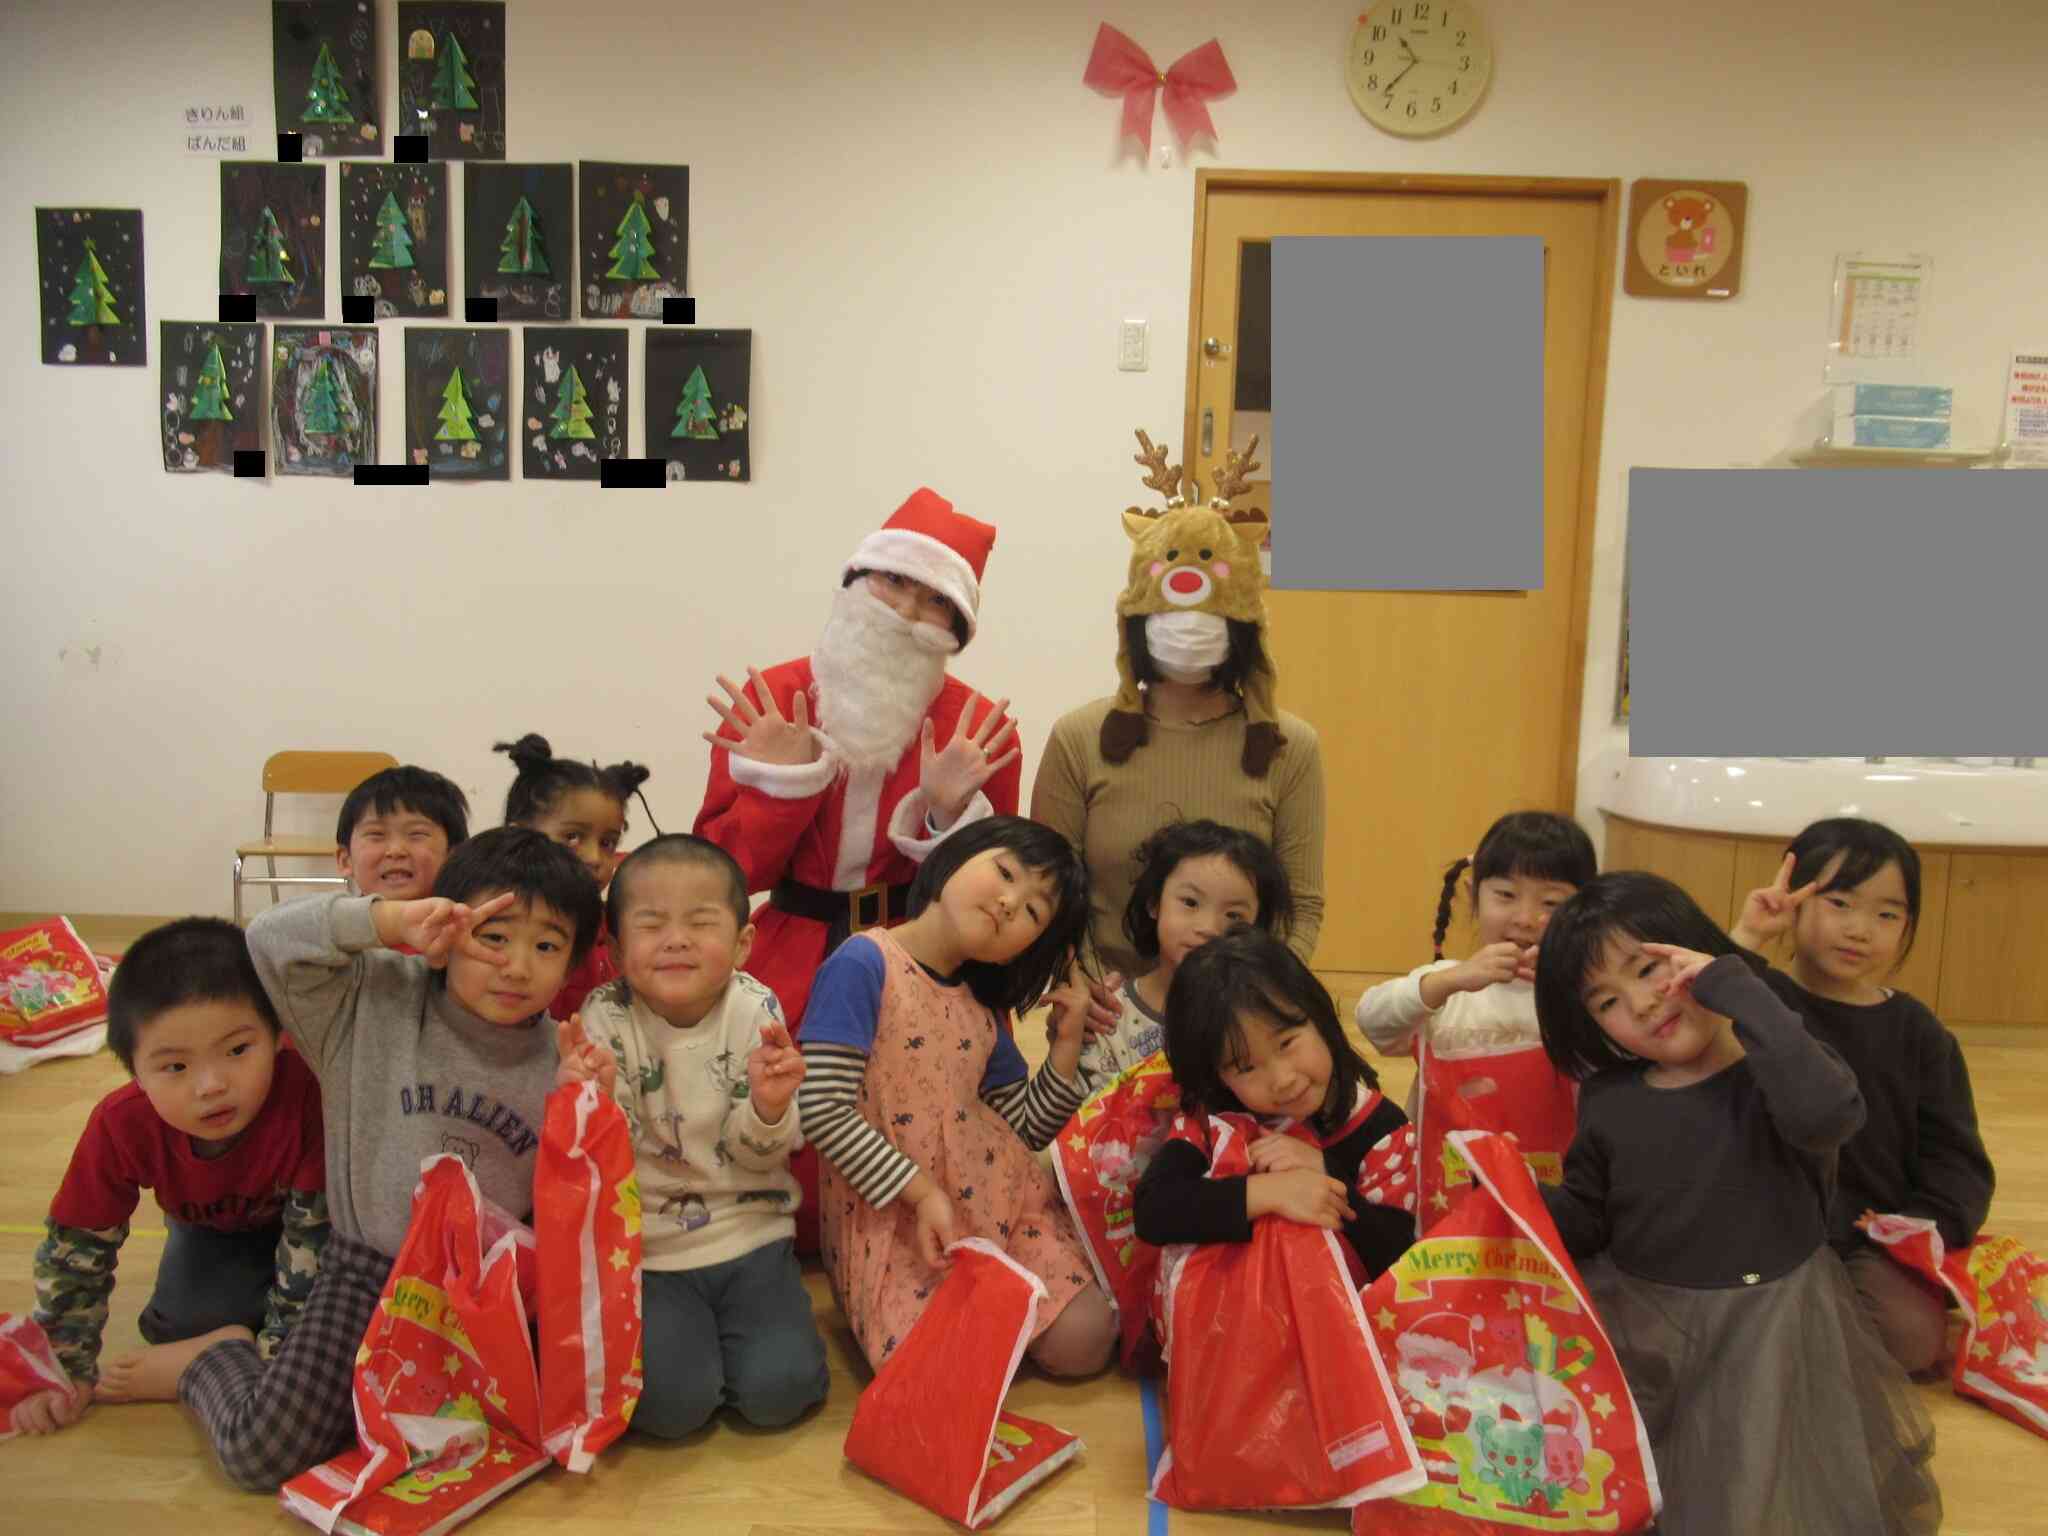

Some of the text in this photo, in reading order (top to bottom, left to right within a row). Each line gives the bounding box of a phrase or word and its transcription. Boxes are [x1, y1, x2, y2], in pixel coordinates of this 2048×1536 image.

[1391, 8, 1402, 25] 11
[1413, 2, 1430, 21] 12
[1371, 24, 1387, 42] 10
[1456, 30, 1467, 47] 2
[1363, 49, 1375, 65] 9
[1458, 55, 1470, 72] 3
[1367, 73, 1378, 89] 8
[1448, 79, 1457, 95] 4
[1383, 92, 1394, 110] 7
[1405, 101, 1417, 118] 6
[1430, 97, 1441, 113] 5
[1658, 263, 1706, 277] といれ
[401, 1085, 539, 1157] OH ALIEN
[1408, 1246, 1479, 1274] Merry
